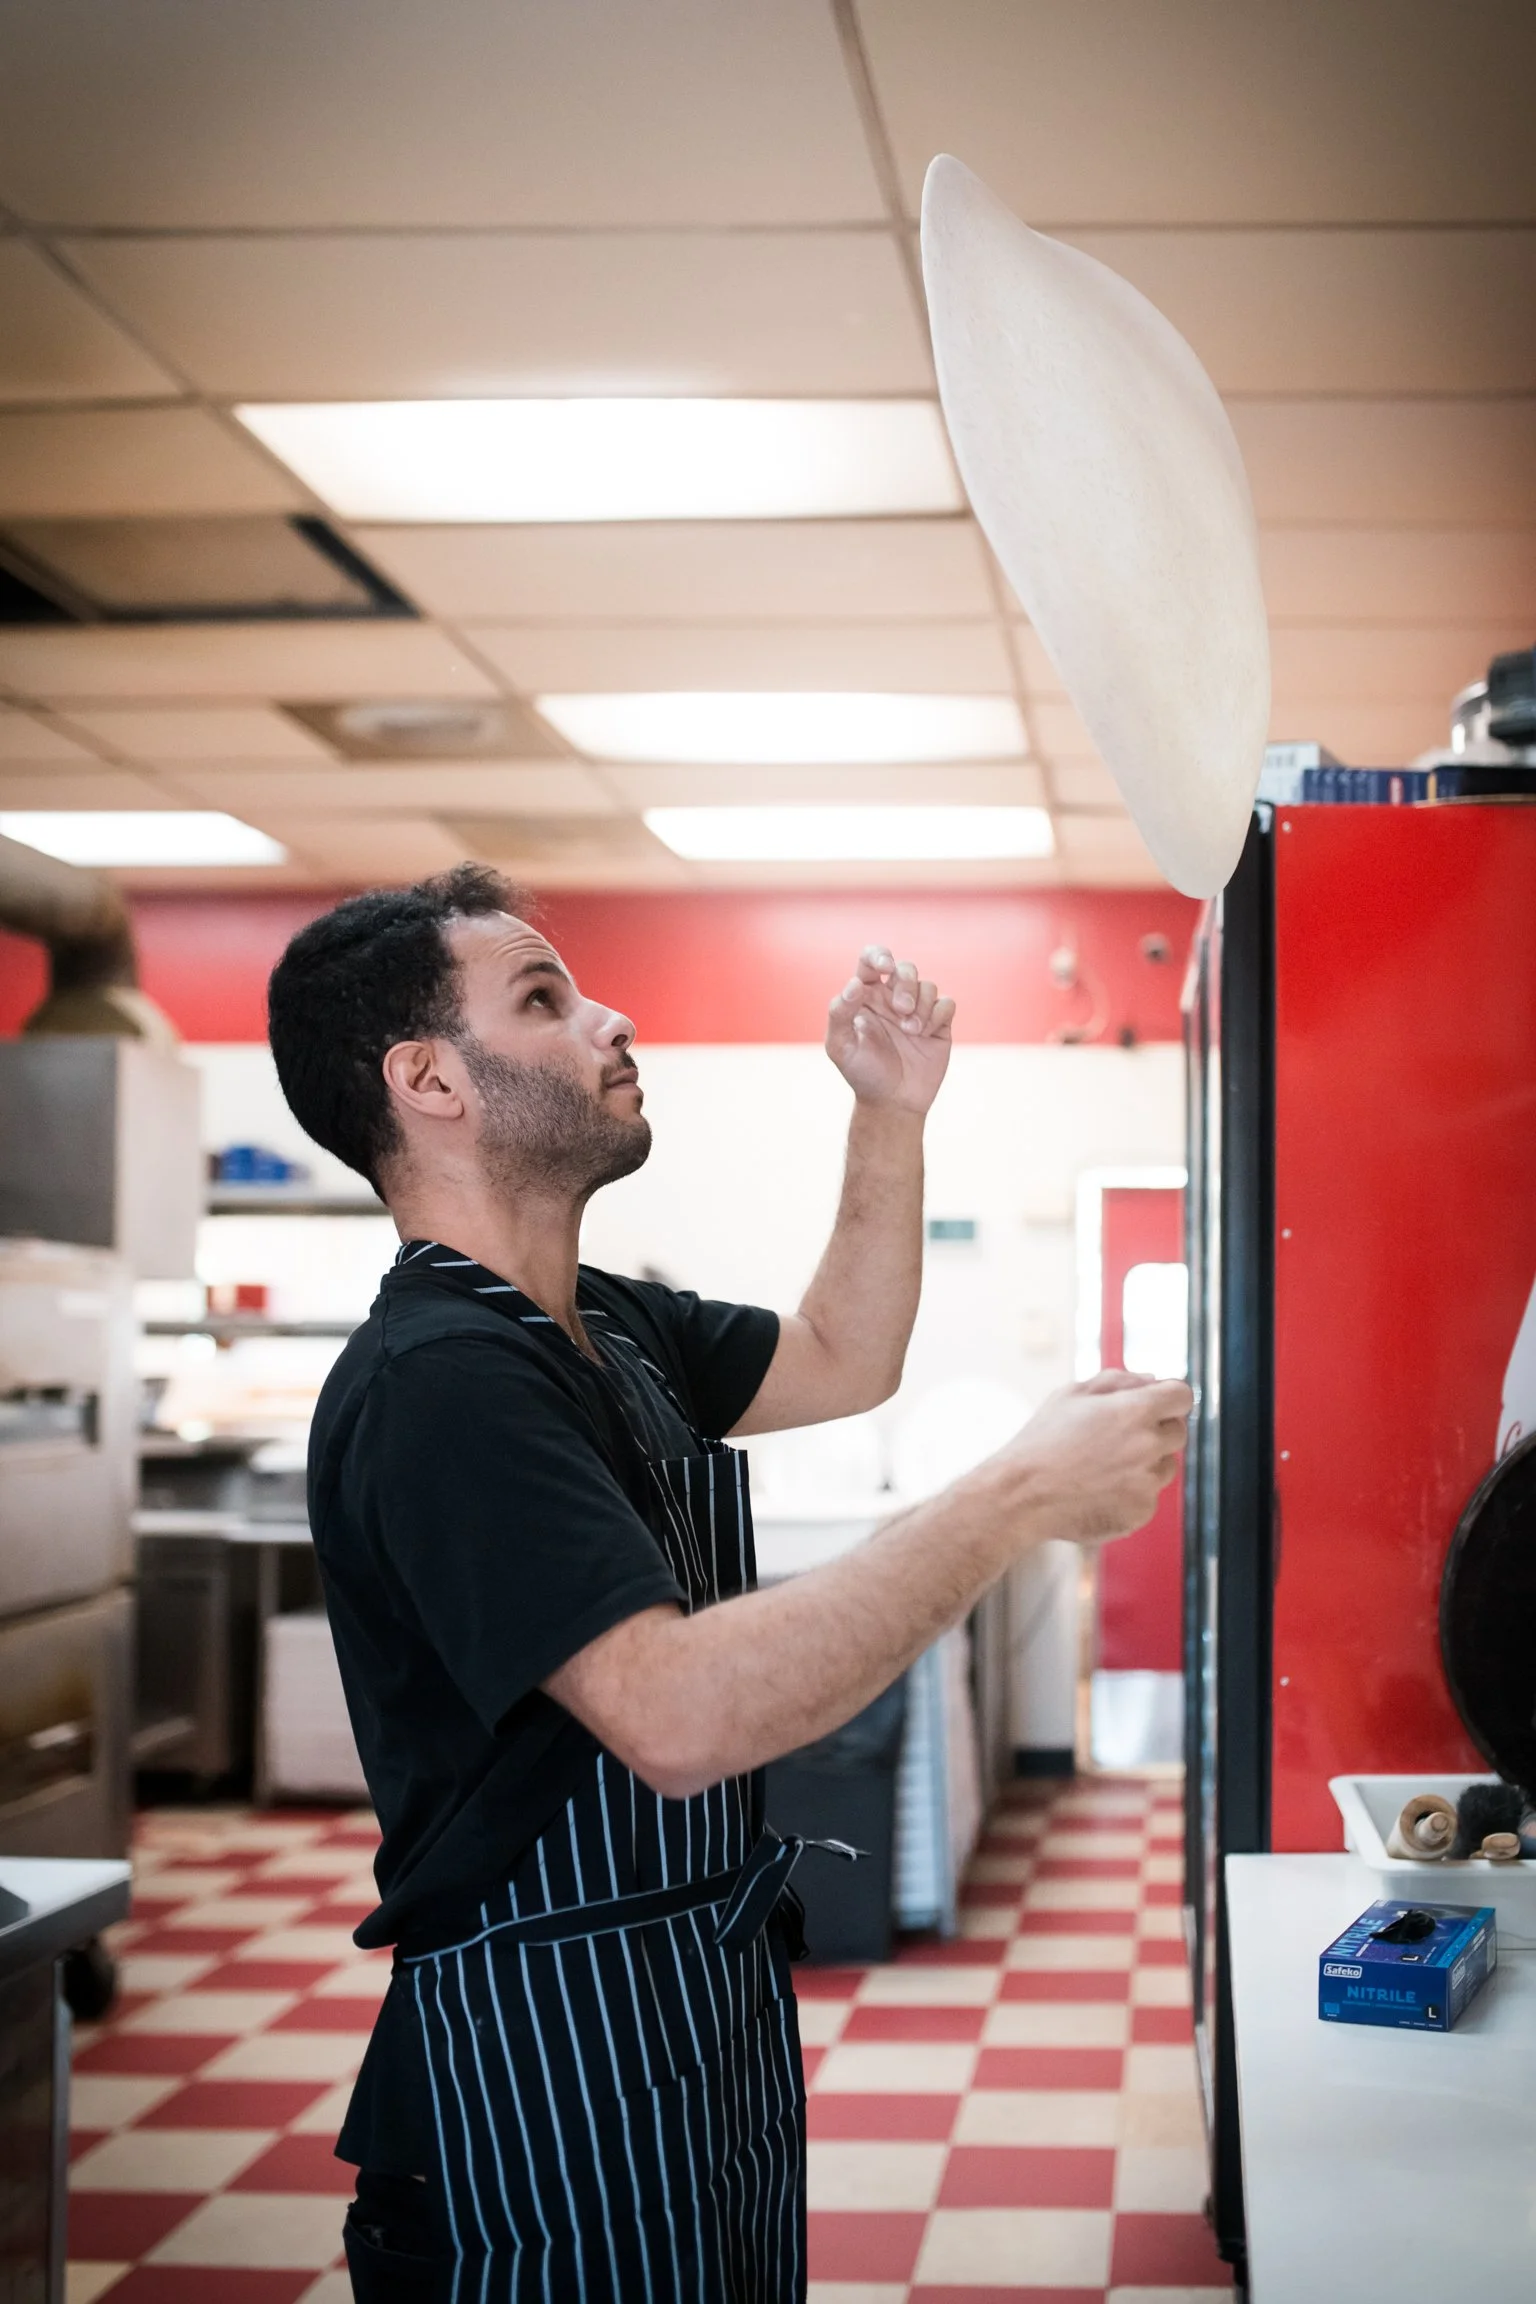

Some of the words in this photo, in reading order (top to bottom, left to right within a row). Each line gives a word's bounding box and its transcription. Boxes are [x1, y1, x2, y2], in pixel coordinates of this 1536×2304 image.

[1327, 1917, 1384, 1957] NITRILE
[1326, 1965, 1360, 1977] Safeko
[1347, 1985, 1416, 2003] NITRILE
[1428, 2007, 1437, 2019] L
